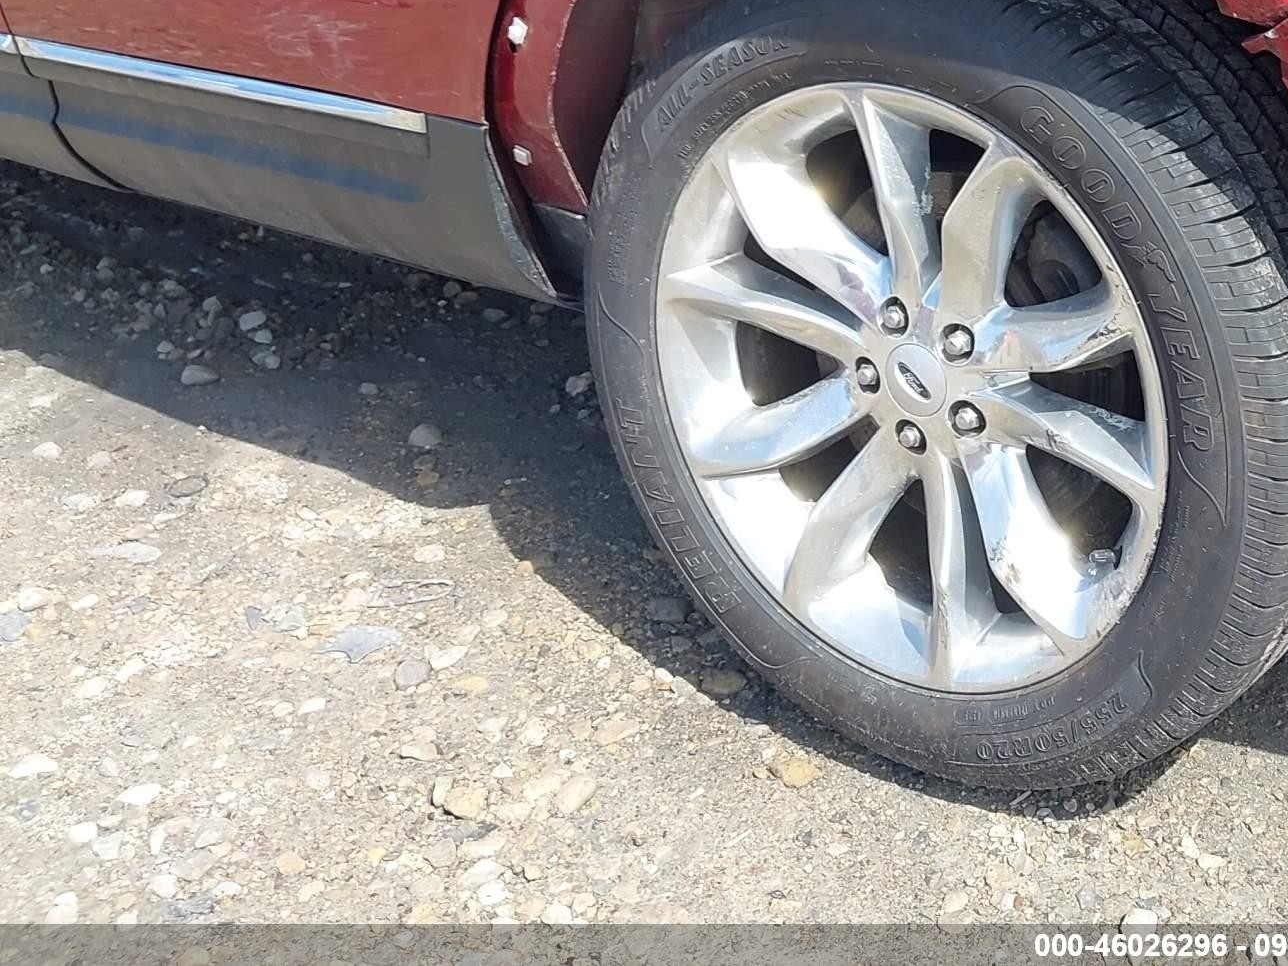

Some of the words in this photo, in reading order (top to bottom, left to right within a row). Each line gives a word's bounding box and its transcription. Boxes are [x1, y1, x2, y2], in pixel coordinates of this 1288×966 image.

[1019, 104, 1215, 452] GOODYEAR
[616, 397, 742, 614] RELIANT
[975, 690, 1129, 761] 255/50R20
